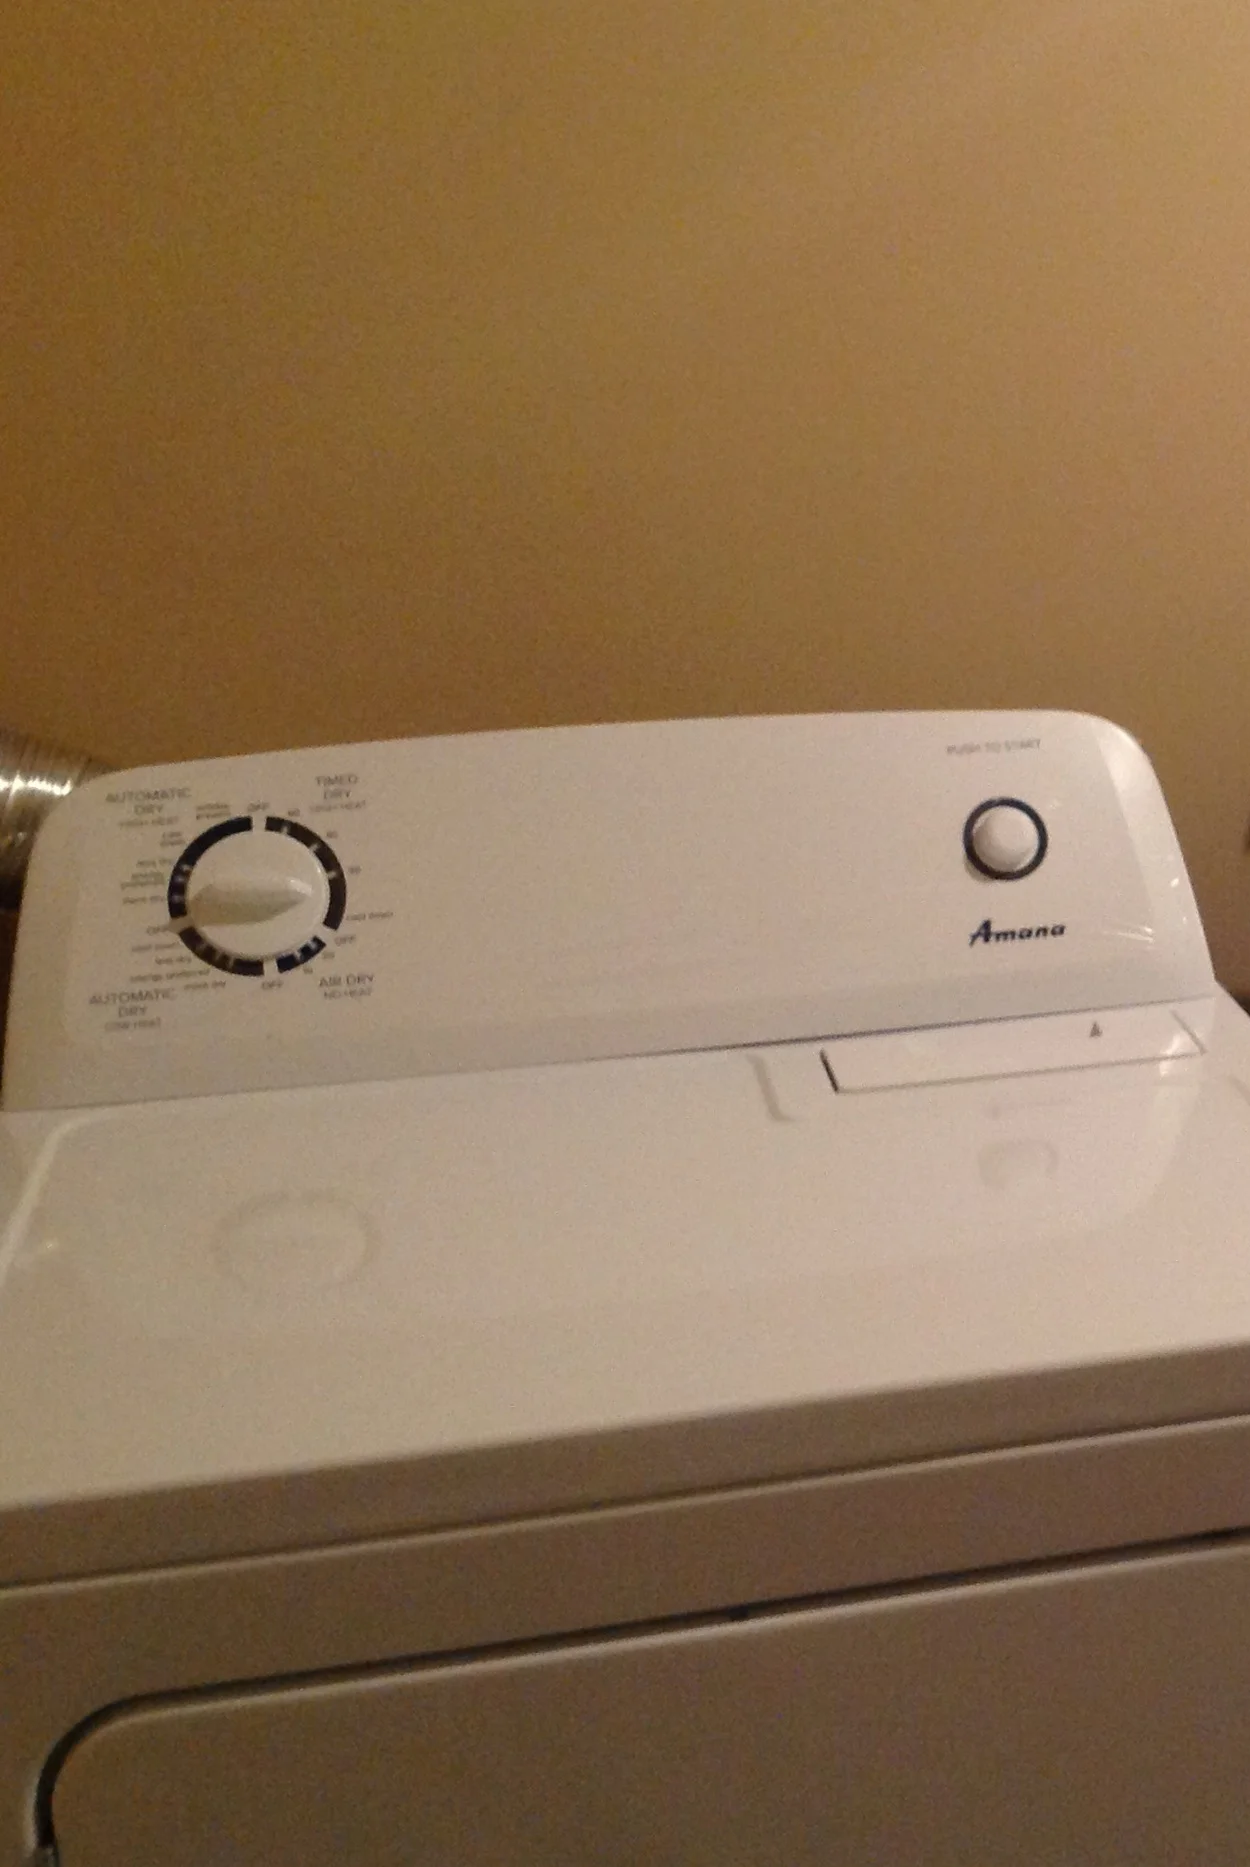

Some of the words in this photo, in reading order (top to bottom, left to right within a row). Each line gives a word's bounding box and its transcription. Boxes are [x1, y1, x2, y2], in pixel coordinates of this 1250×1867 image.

[315, 773, 359, 787] TIMED
[104, 787, 192, 803] AUTOMATIC
[133, 803, 164, 816] DRY
[968, 918, 1066, 948] Amana
[345, 973, 376, 986] DRY
[88, 987, 177, 1006] AUTOMATIC
[118, 1004, 148, 1019] DRY
